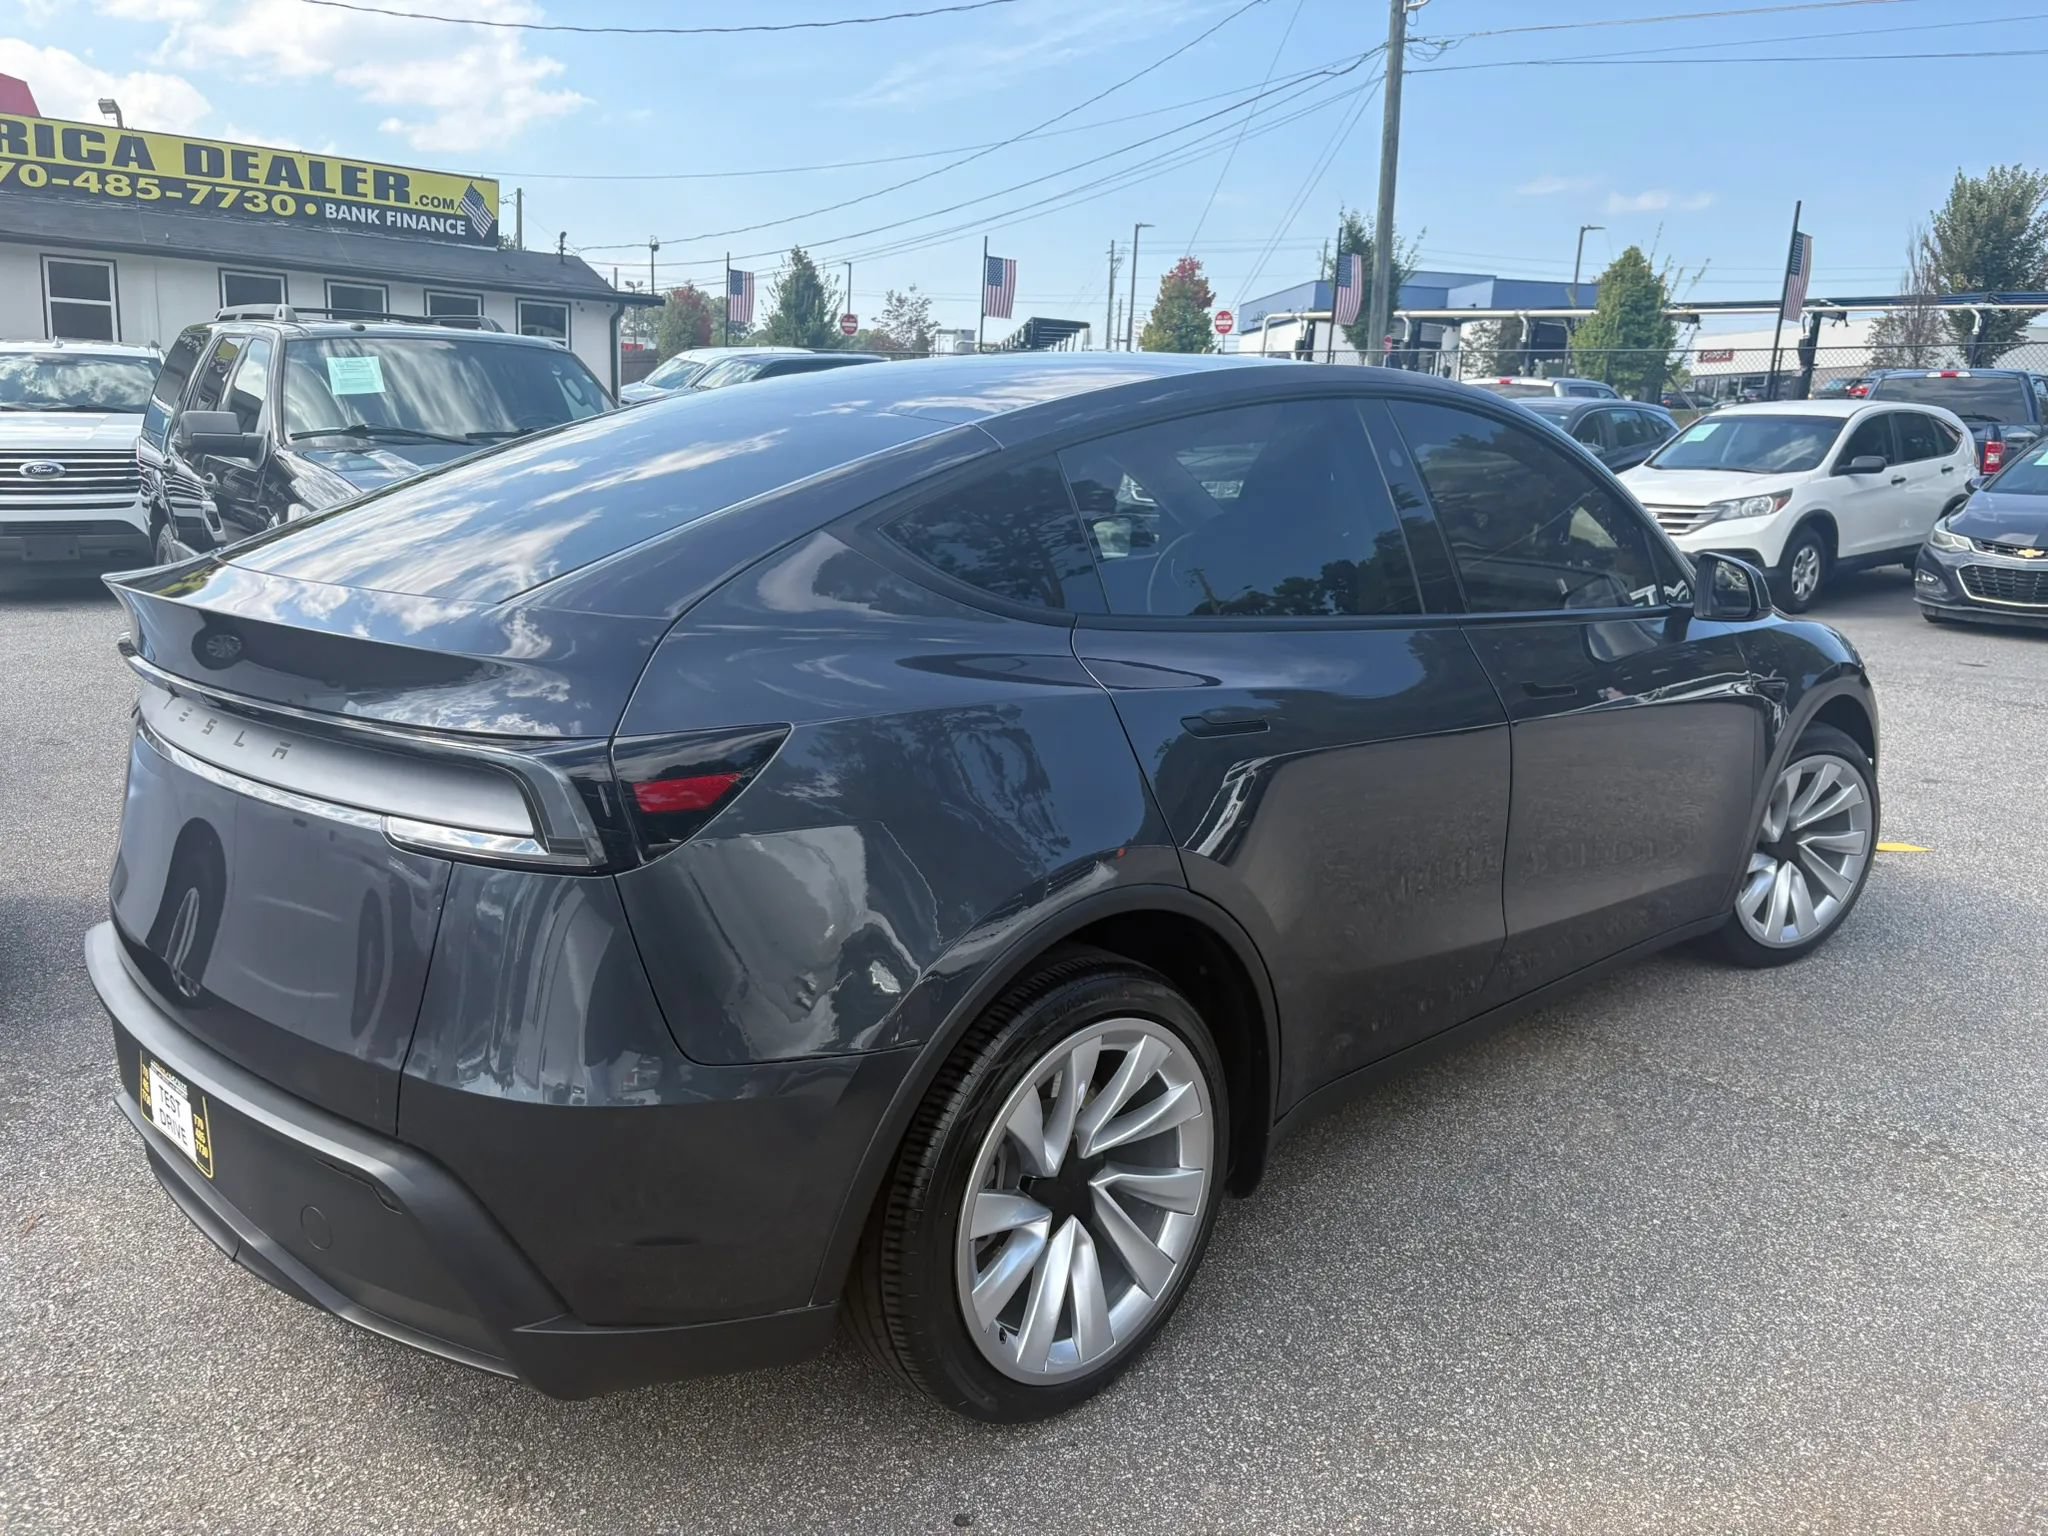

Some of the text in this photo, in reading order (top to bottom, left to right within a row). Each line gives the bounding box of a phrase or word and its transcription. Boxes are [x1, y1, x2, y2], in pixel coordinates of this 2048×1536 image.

[325, 203, 381, 225] BANK
[386, 211, 466, 235] FINANCE
[163, 686, 292, 760] TESLA
[159, 1084, 181, 1118] TEST
[159, 1107, 188, 1147] DRIVE
